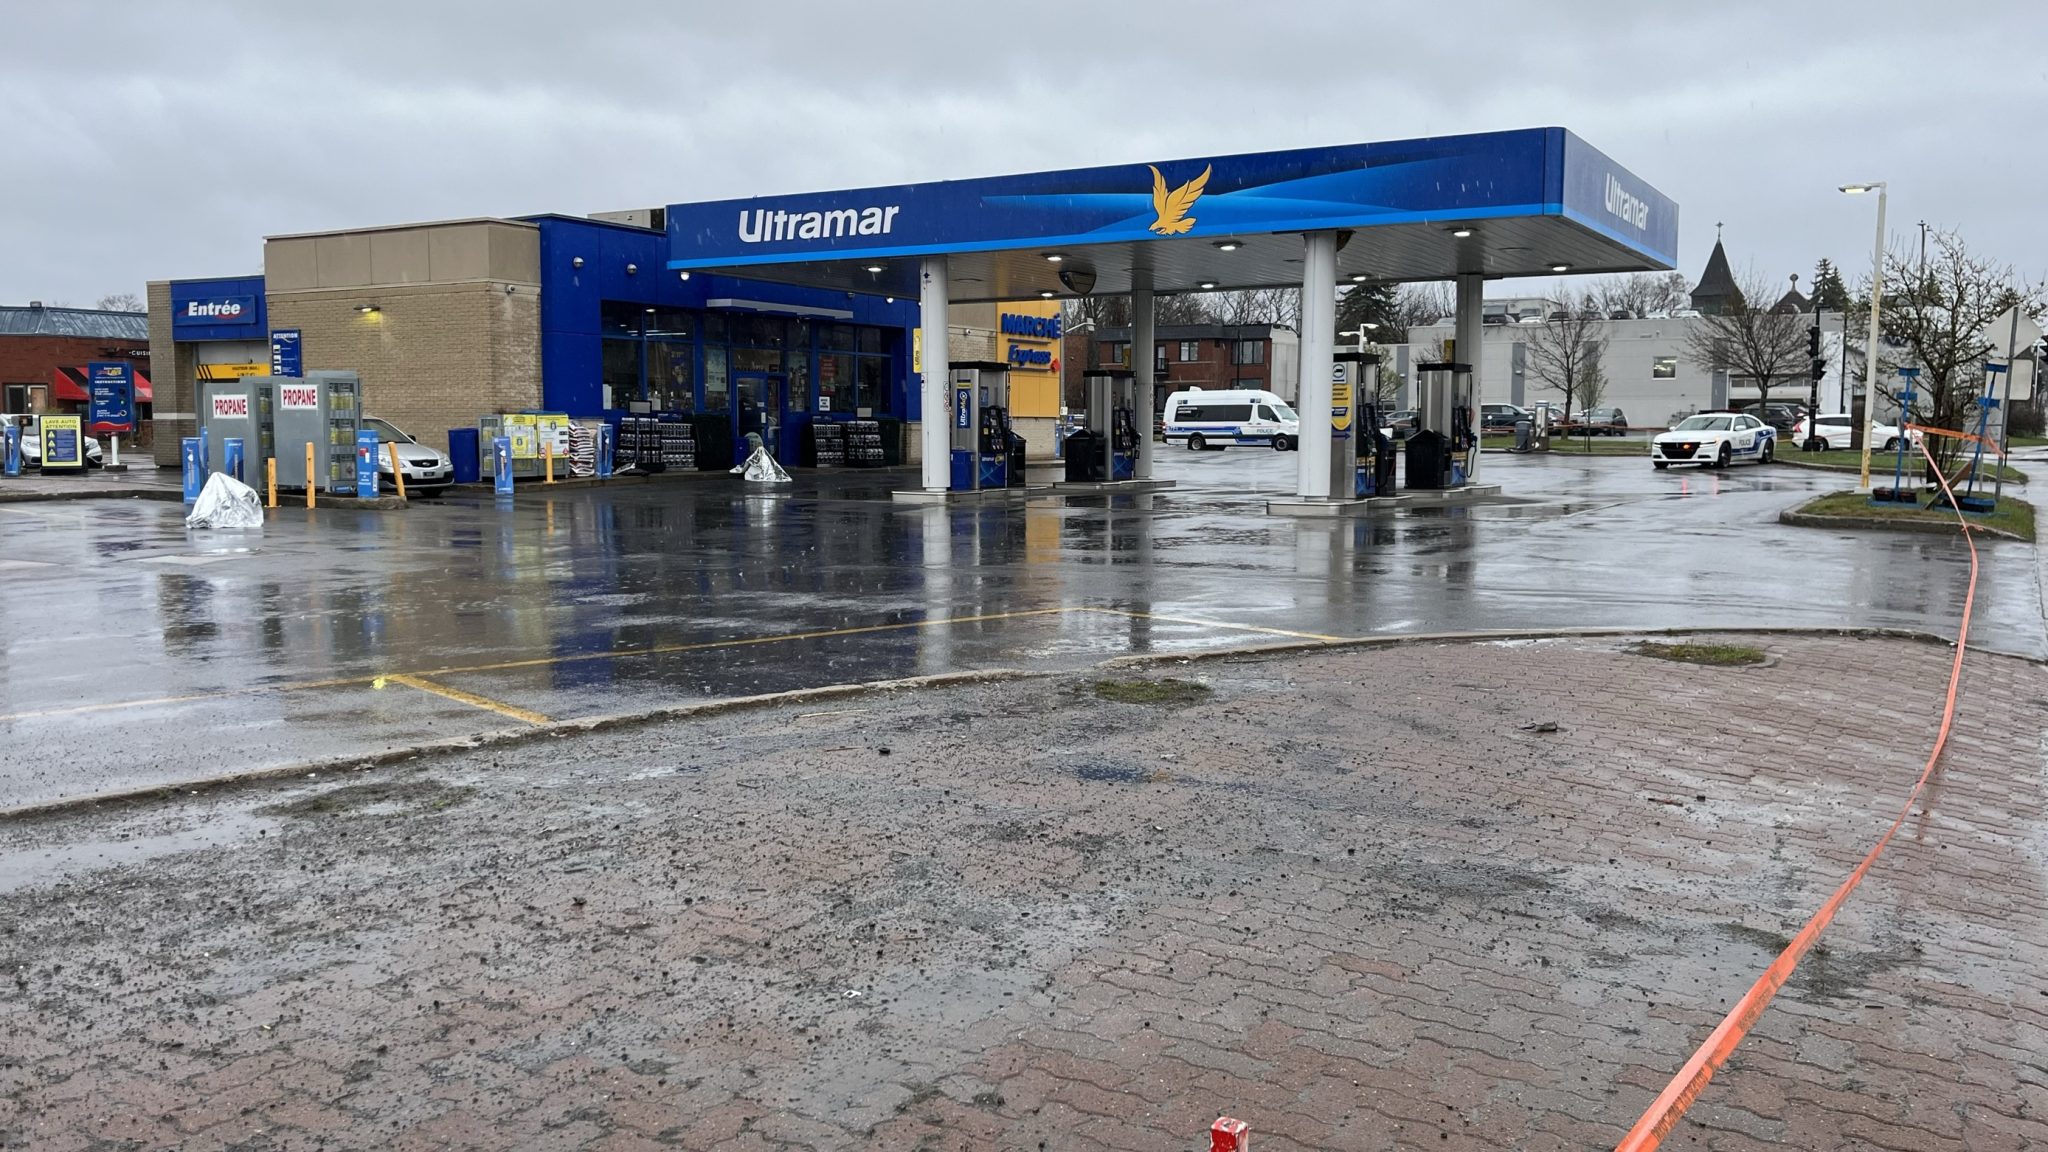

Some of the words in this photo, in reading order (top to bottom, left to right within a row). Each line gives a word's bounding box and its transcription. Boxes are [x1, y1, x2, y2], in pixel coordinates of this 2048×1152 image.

[1605, 172, 1649, 231] Ultramar
[738, 205, 899, 243] Ultramar
[188, 300, 241, 316] Entrée
[1001, 312, 1061, 339] MARCHÉ
[1008, 344, 1051, 366] Express
[214, 399, 247, 415] PROPANE
[283, 389, 316, 406] PROPANE
